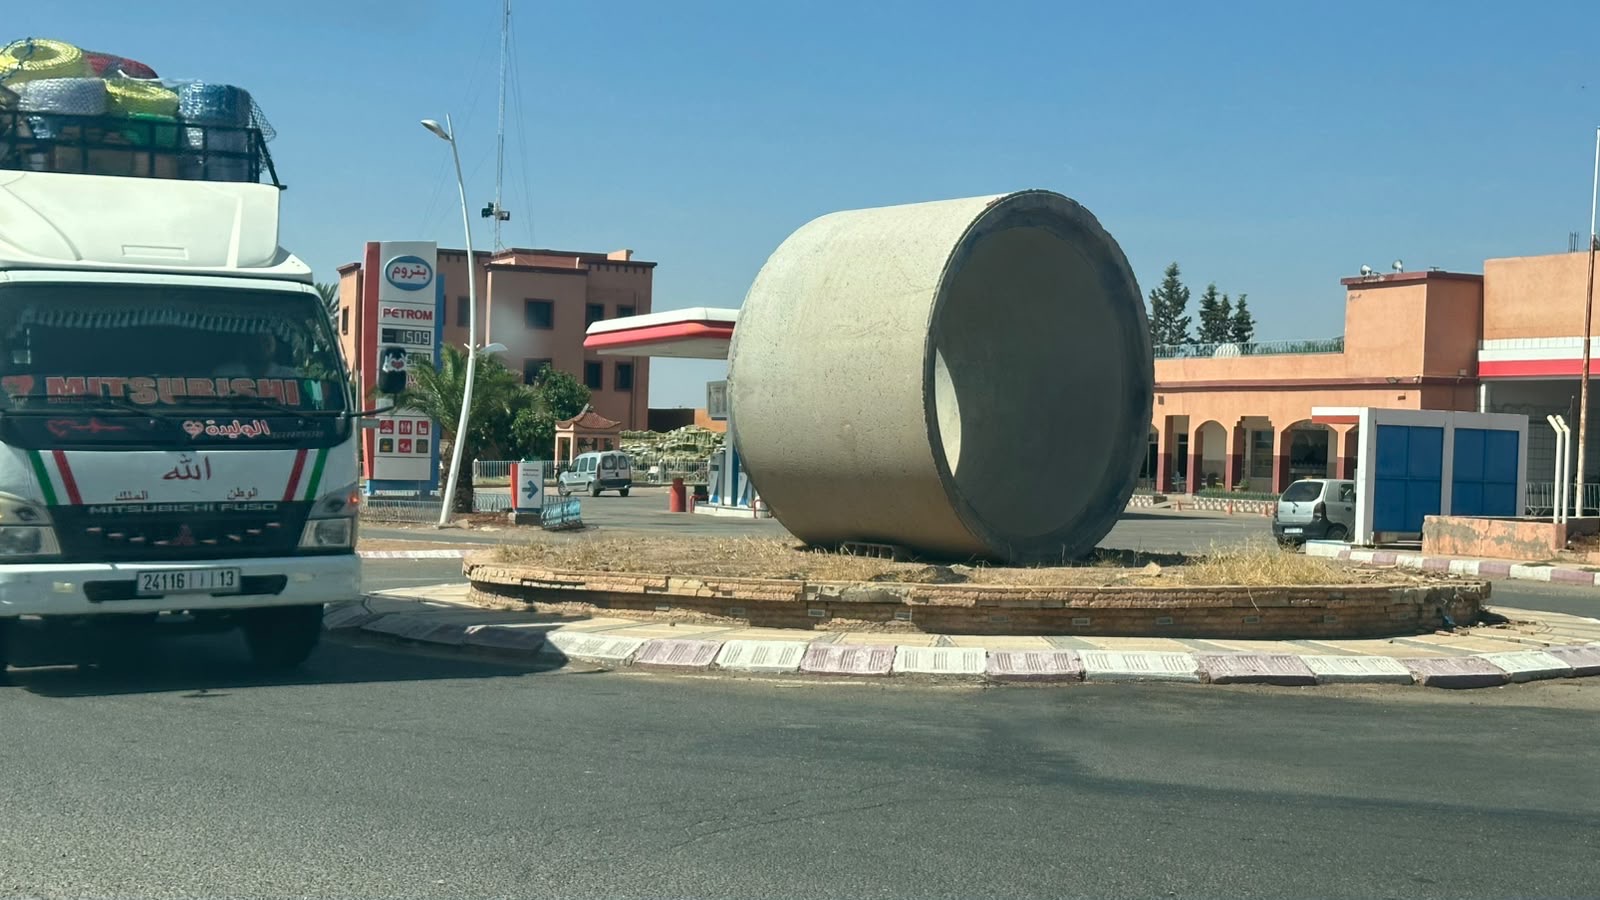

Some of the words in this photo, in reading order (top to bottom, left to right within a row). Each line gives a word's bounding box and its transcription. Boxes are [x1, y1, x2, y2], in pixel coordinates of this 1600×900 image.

[392, 265, 427, 280] بتروم
[383, 308, 432, 321] PETROM
[45, 376, 301, 406] MITSUBISHI
[205, 419, 271, 439] الوليدة
[162, 454, 212, 481] الله
[226, 486, 258, 501] الوطن
[89, 504, 214, 514] MITSUBISHI
[221, 503, 277, 513] FUSO
[143, 573, 185, 590] 24116
[220, 570, 234, 586] 13
